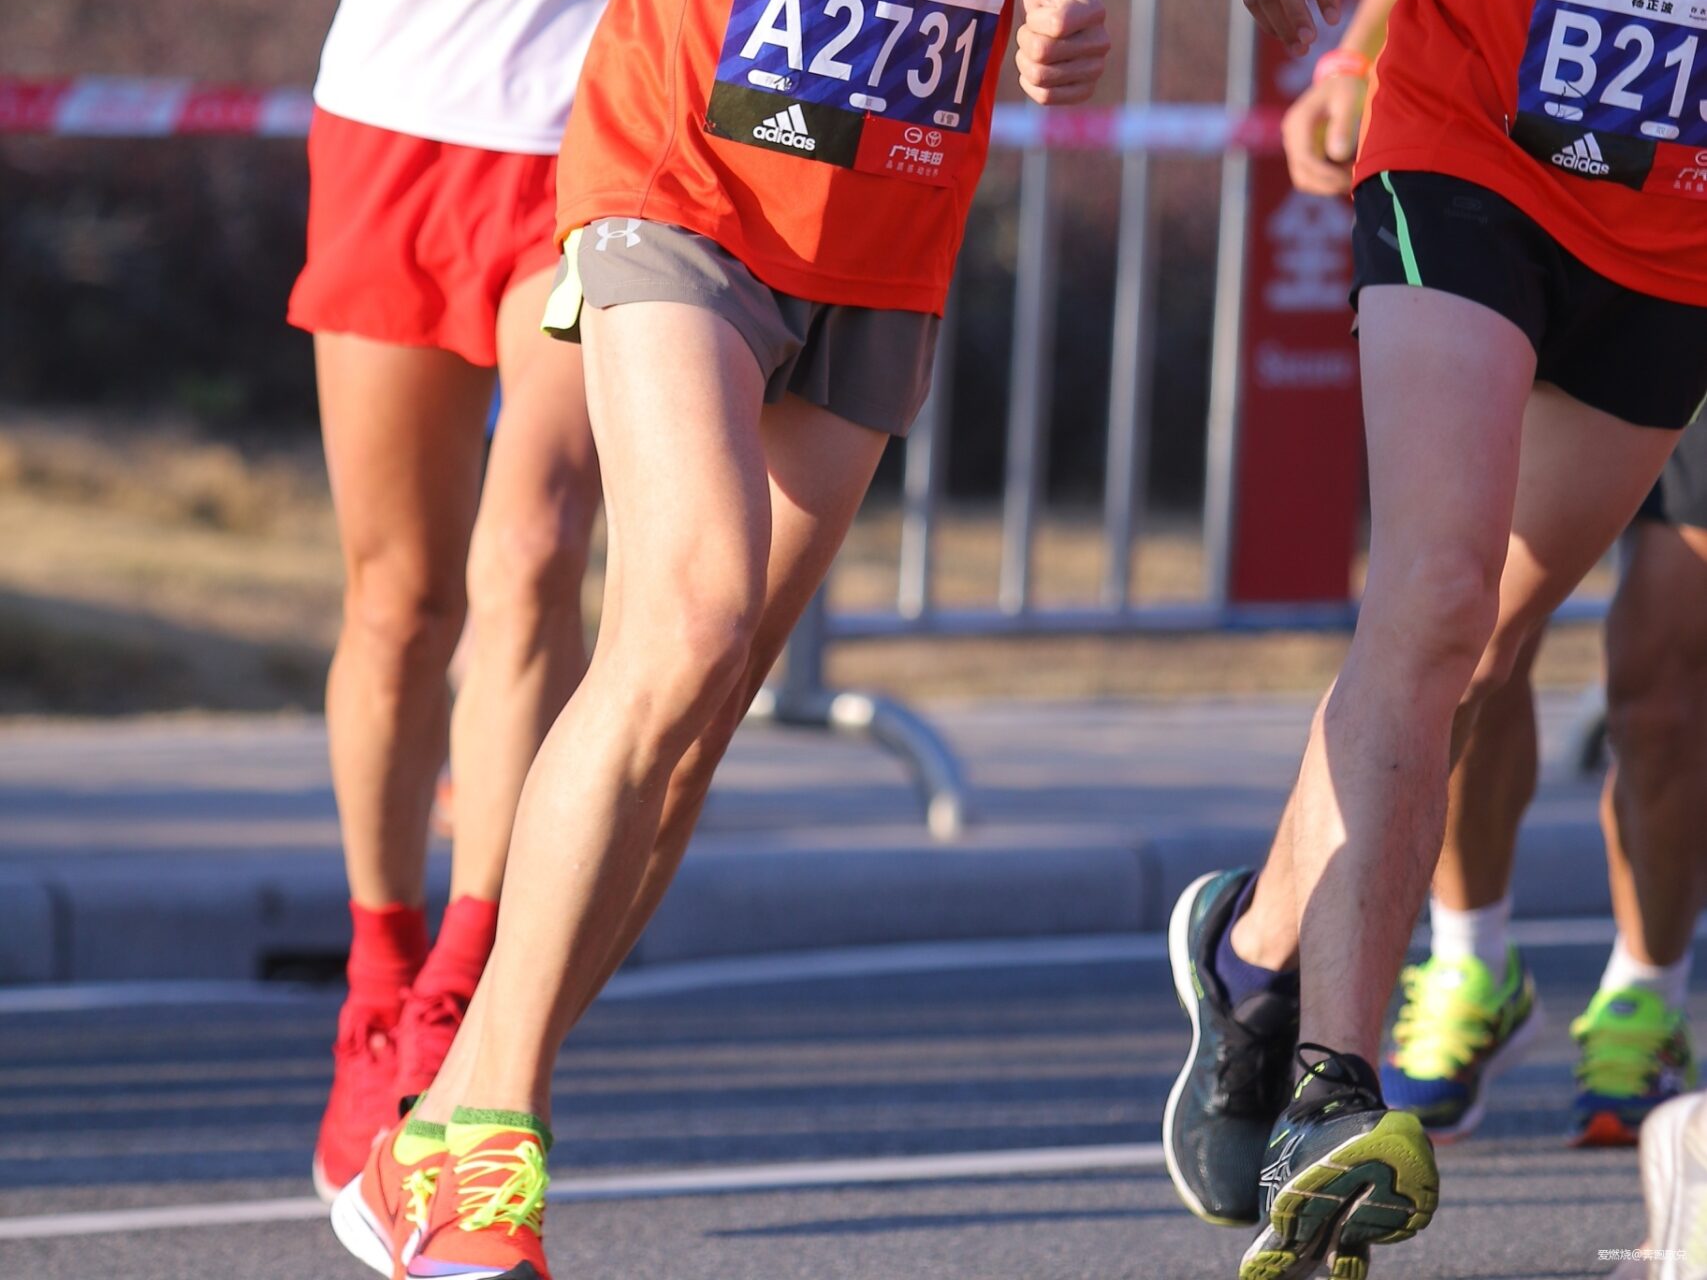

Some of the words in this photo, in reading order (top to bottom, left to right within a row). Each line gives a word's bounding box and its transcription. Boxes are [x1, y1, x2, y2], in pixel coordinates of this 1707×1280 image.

[1539, 8, 1707, 123] B21
[753, 125, 816, 152] adidas
[889, 145, 944, 166] 广汽丰田
[1551, 151, 1610, 175] adidas
